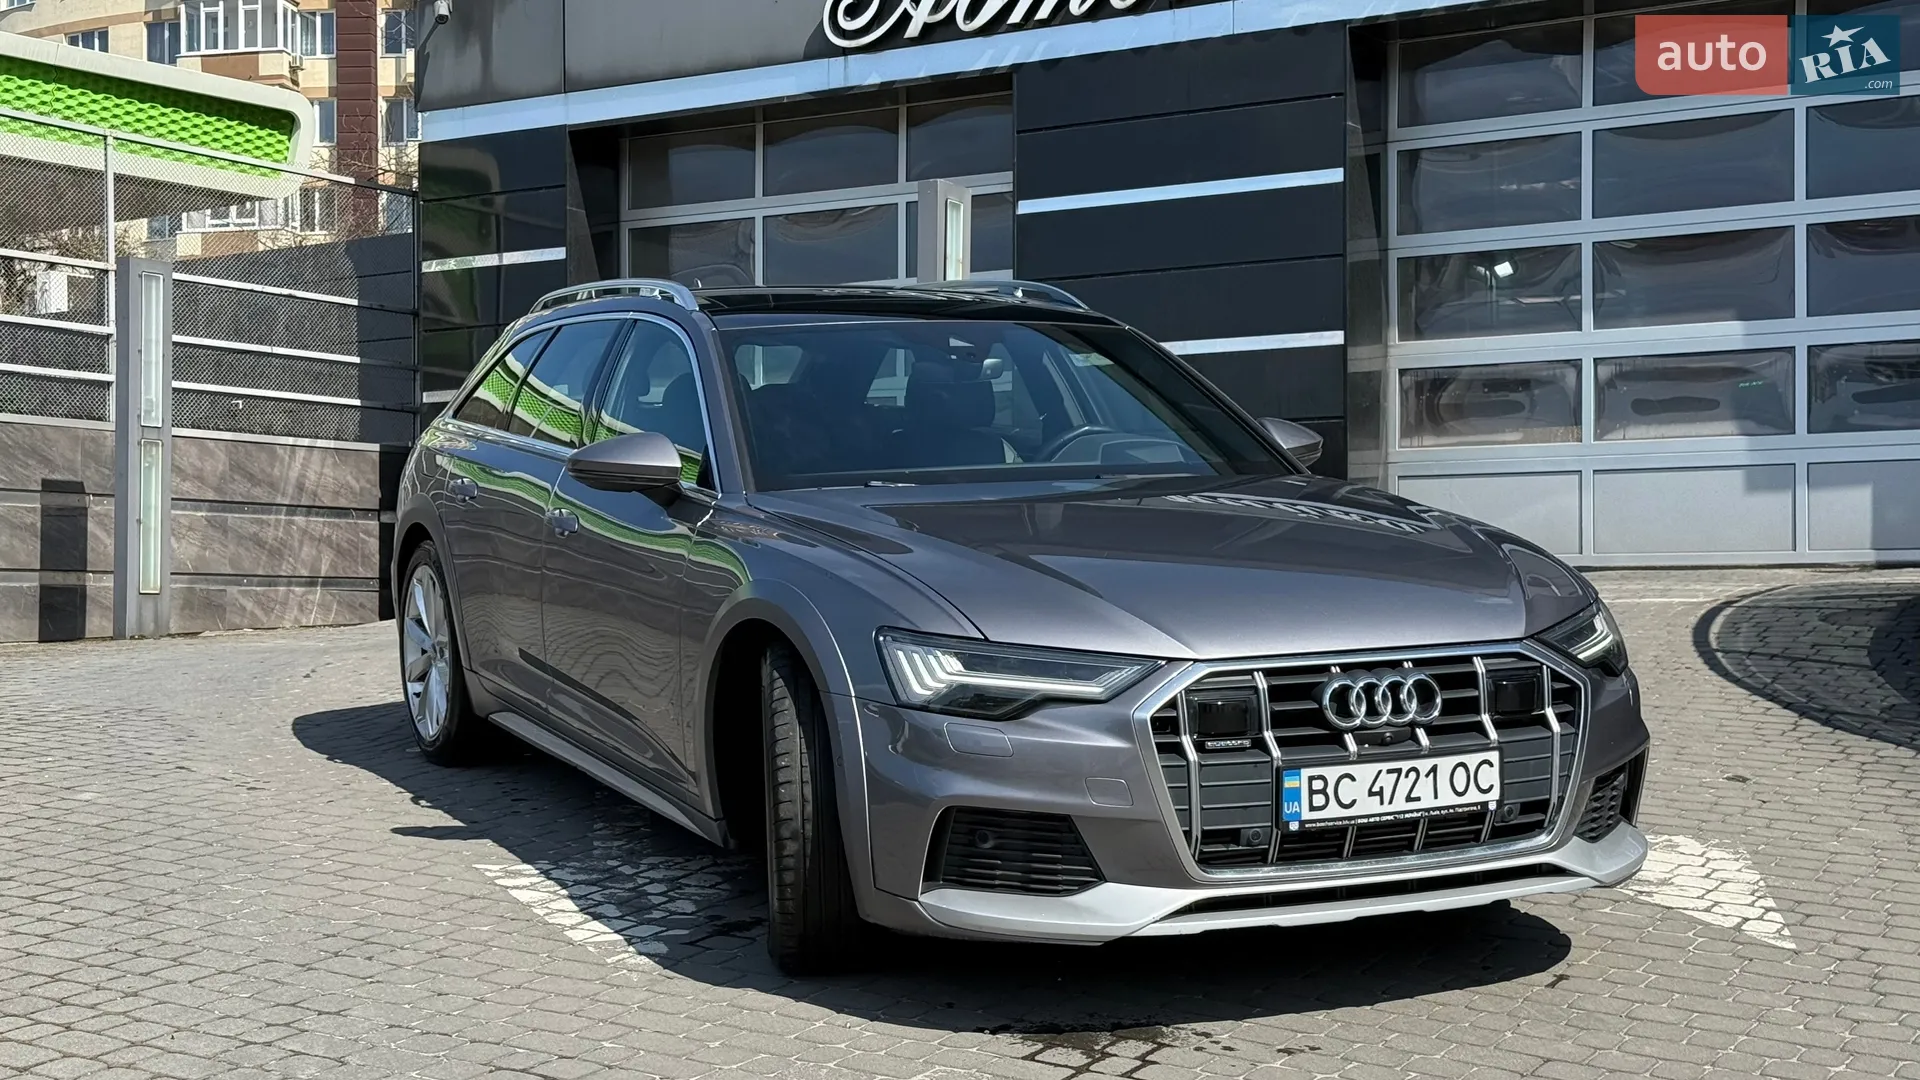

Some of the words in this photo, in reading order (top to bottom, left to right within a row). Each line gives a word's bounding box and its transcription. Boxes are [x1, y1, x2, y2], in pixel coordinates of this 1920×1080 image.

[1308, 772, 1358, 812] BC
[1367, 763, 1438, 806] 4721
[1449, 759, 1495, 797] OC
[1284, 801, 1300, 814] UA
